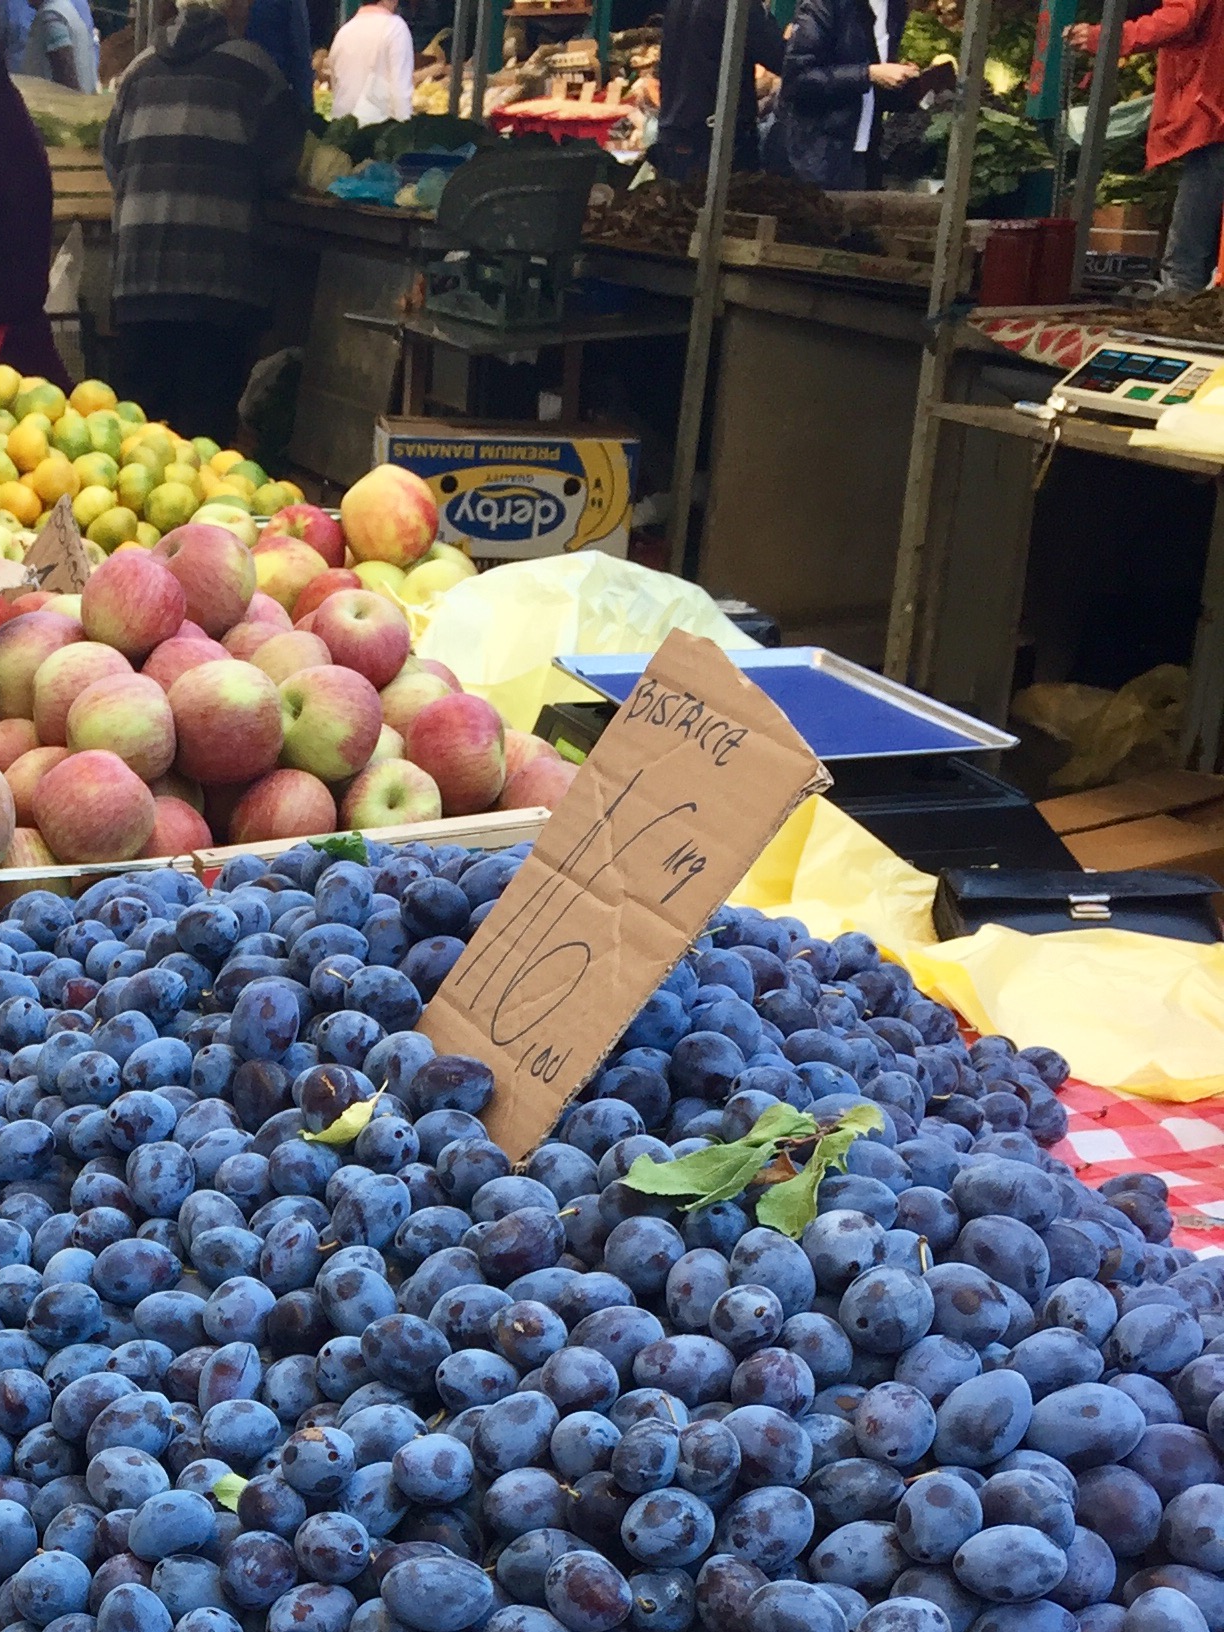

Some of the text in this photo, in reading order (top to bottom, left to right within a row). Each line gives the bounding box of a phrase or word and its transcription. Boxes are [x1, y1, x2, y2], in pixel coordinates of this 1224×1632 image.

[1084, 256, 1127, 273] RUIT
[393, 442, 561, 461] PREMIUM BANANAS
[454, 489, 558, 539] derby
